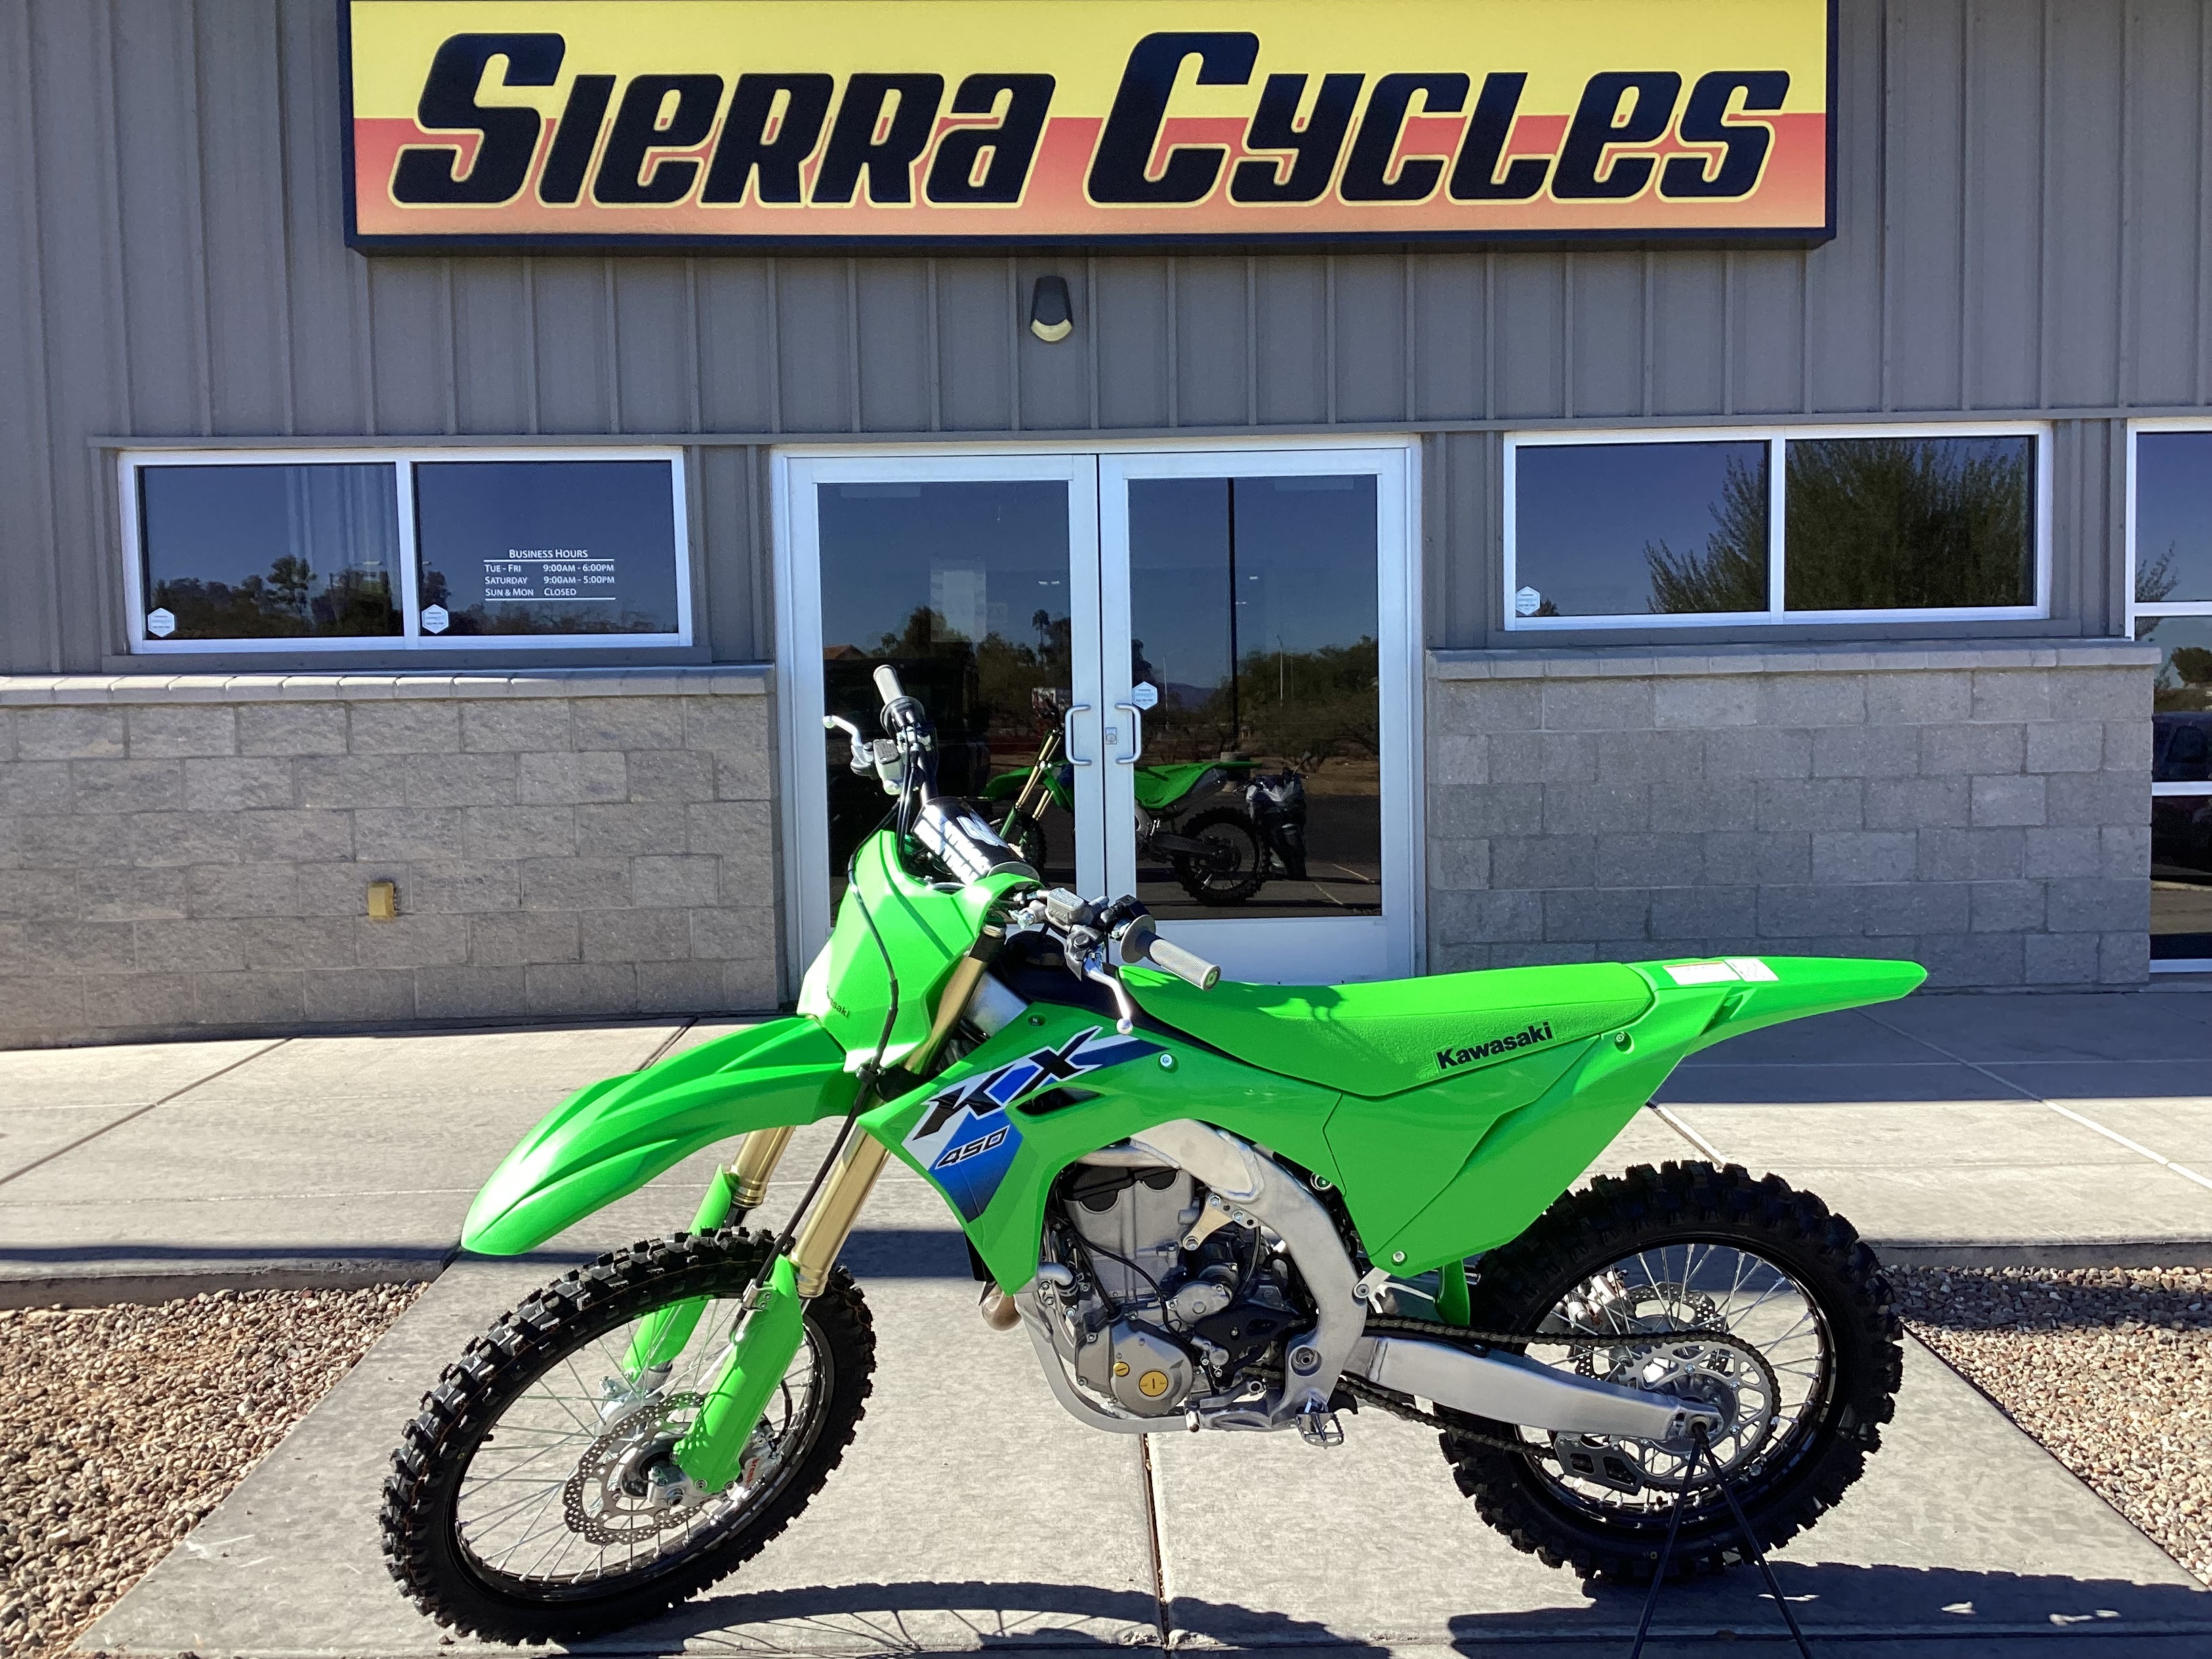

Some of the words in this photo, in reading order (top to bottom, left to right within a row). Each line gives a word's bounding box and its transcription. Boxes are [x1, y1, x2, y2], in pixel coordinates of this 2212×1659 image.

[509, 550, 553, 558] BUSINESS
[555, 549, 588, 558] HOURS
[485, 565, 501, 573] TUE
[508, 565, 521, 573] FRI
[543, 564, 576, 572] 9:00AM
[582, 564, 614, 572] 6:00PM
[485, 576, 528, 584] SATURDAY
[485, 588, 504, 596] SUN
[504, 588, 511, 596] &
[512, 588, 534, 596] MON
[544, 588, 577, 596] CLOSED
[1436, 1021, 1553, 1070] Kawasaki
[912, 1026, 1101, 1141] KX
[935, 1125, 1010, 1169] 450
